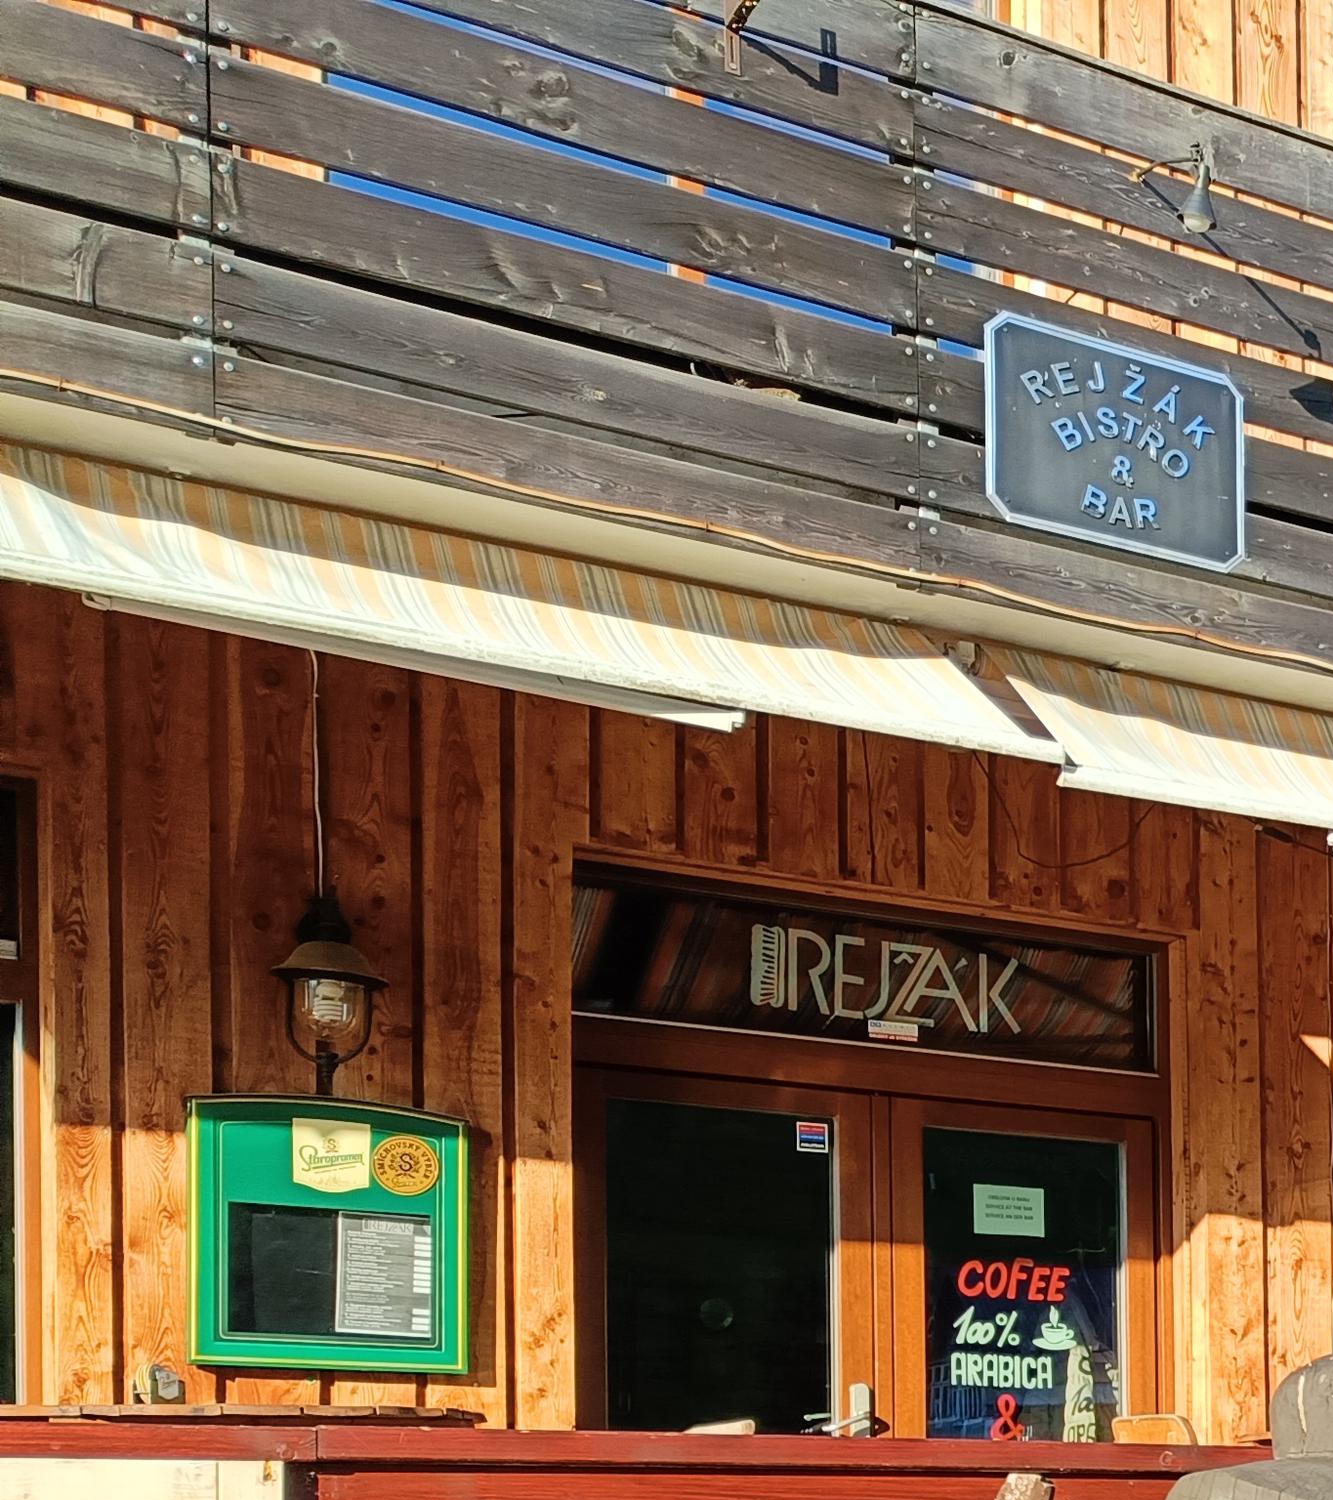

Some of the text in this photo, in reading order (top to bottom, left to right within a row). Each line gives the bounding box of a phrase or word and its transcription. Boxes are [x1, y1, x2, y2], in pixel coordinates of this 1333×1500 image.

[1050, 407, 1191, 479] BISTRO
[1110, 455, 1135, 489] &
[1080, 484, 1161, 531] BAR
[299, 1145, 365, 1172] Staropramen
[958, 1257, 1071, 1302] COFEE
[953, 1305, 1020, 1348] 100%
[950, 1352, 1053, 1389] ARABICA
[990, 1393, 1023, 1442] &
